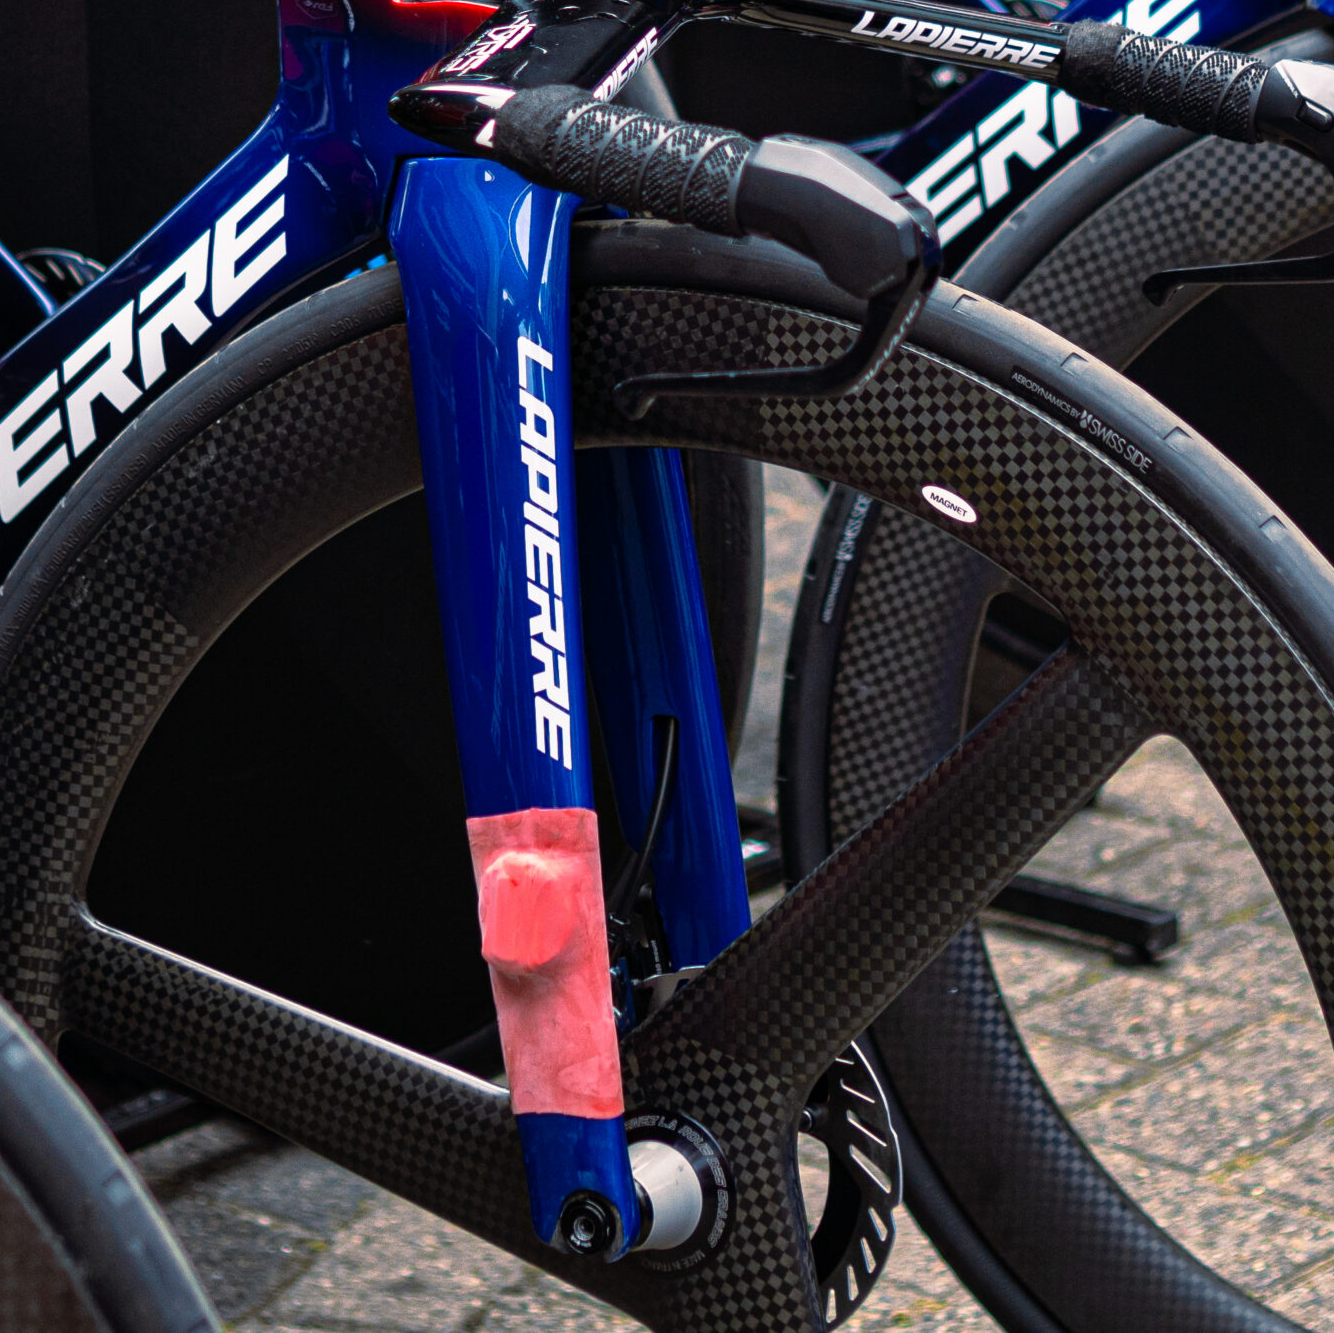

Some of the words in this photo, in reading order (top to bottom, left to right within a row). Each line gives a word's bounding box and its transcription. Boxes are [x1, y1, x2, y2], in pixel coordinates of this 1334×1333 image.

[850, 10, 1062, 69] LAPIERRE
[1011, 371, 1072, 414] AERODYNAMICS
[1068, 406, 1081, 419] BY
[1088, 418, 1126, 455] SWISS
[1123, 445, 1153, 475] SIDE
[929, 492, 968, 518] MAGNET
[516, 334, 572, 771] LAPIERRE
